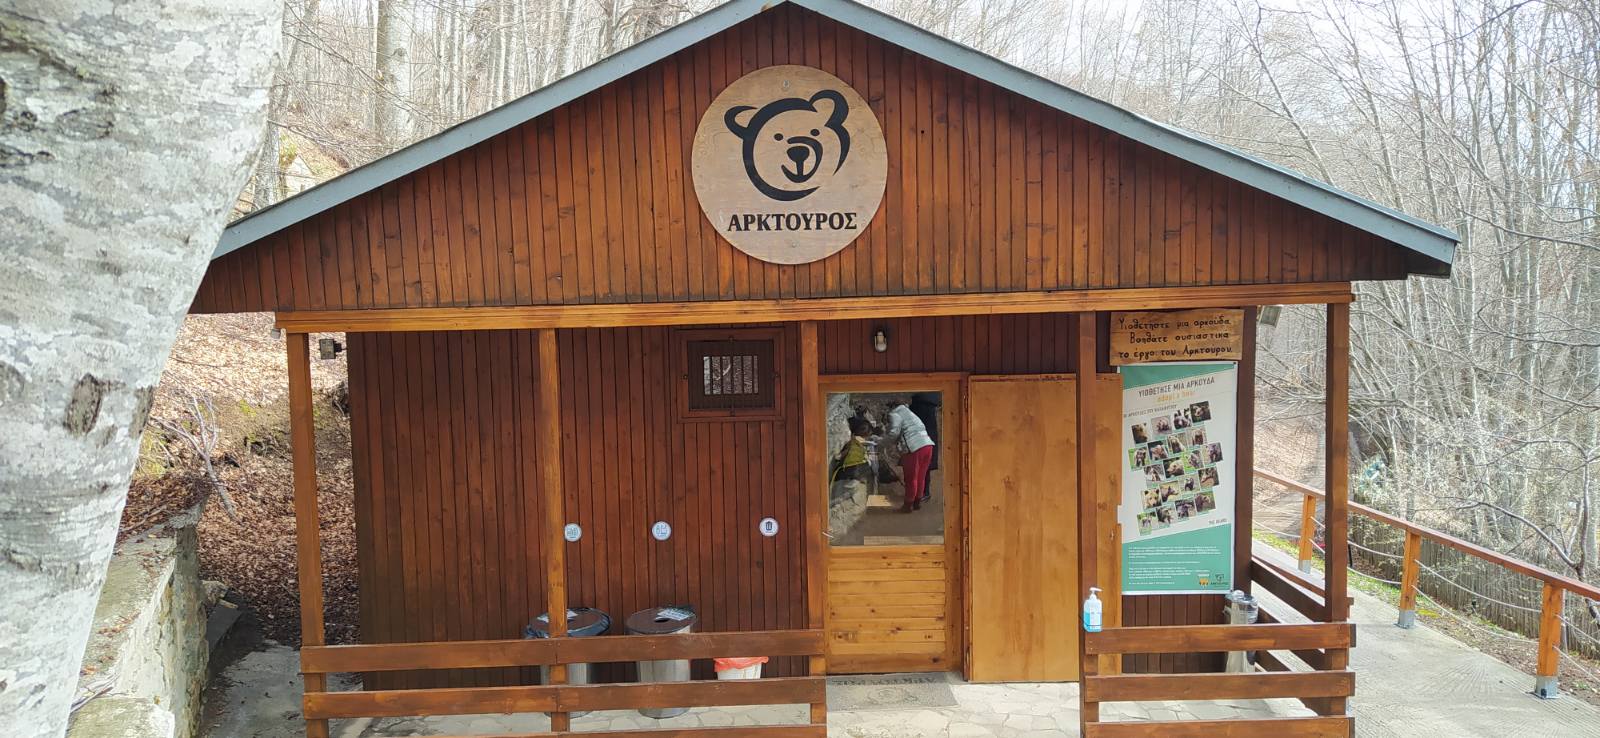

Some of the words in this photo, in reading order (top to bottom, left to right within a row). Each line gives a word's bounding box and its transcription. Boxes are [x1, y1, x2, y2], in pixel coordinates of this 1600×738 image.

[727, 212, 858, 232] ΑΡΚΤΟΥΡΟΣ
[1118, 350, 1130, 358] το
[1161, 348, 1176, 356] του
[1173, 381, 1185, 391] ΜΙΑ
[1186, 376, 1215, 388] ΑΡΚΟΥΔΑ
